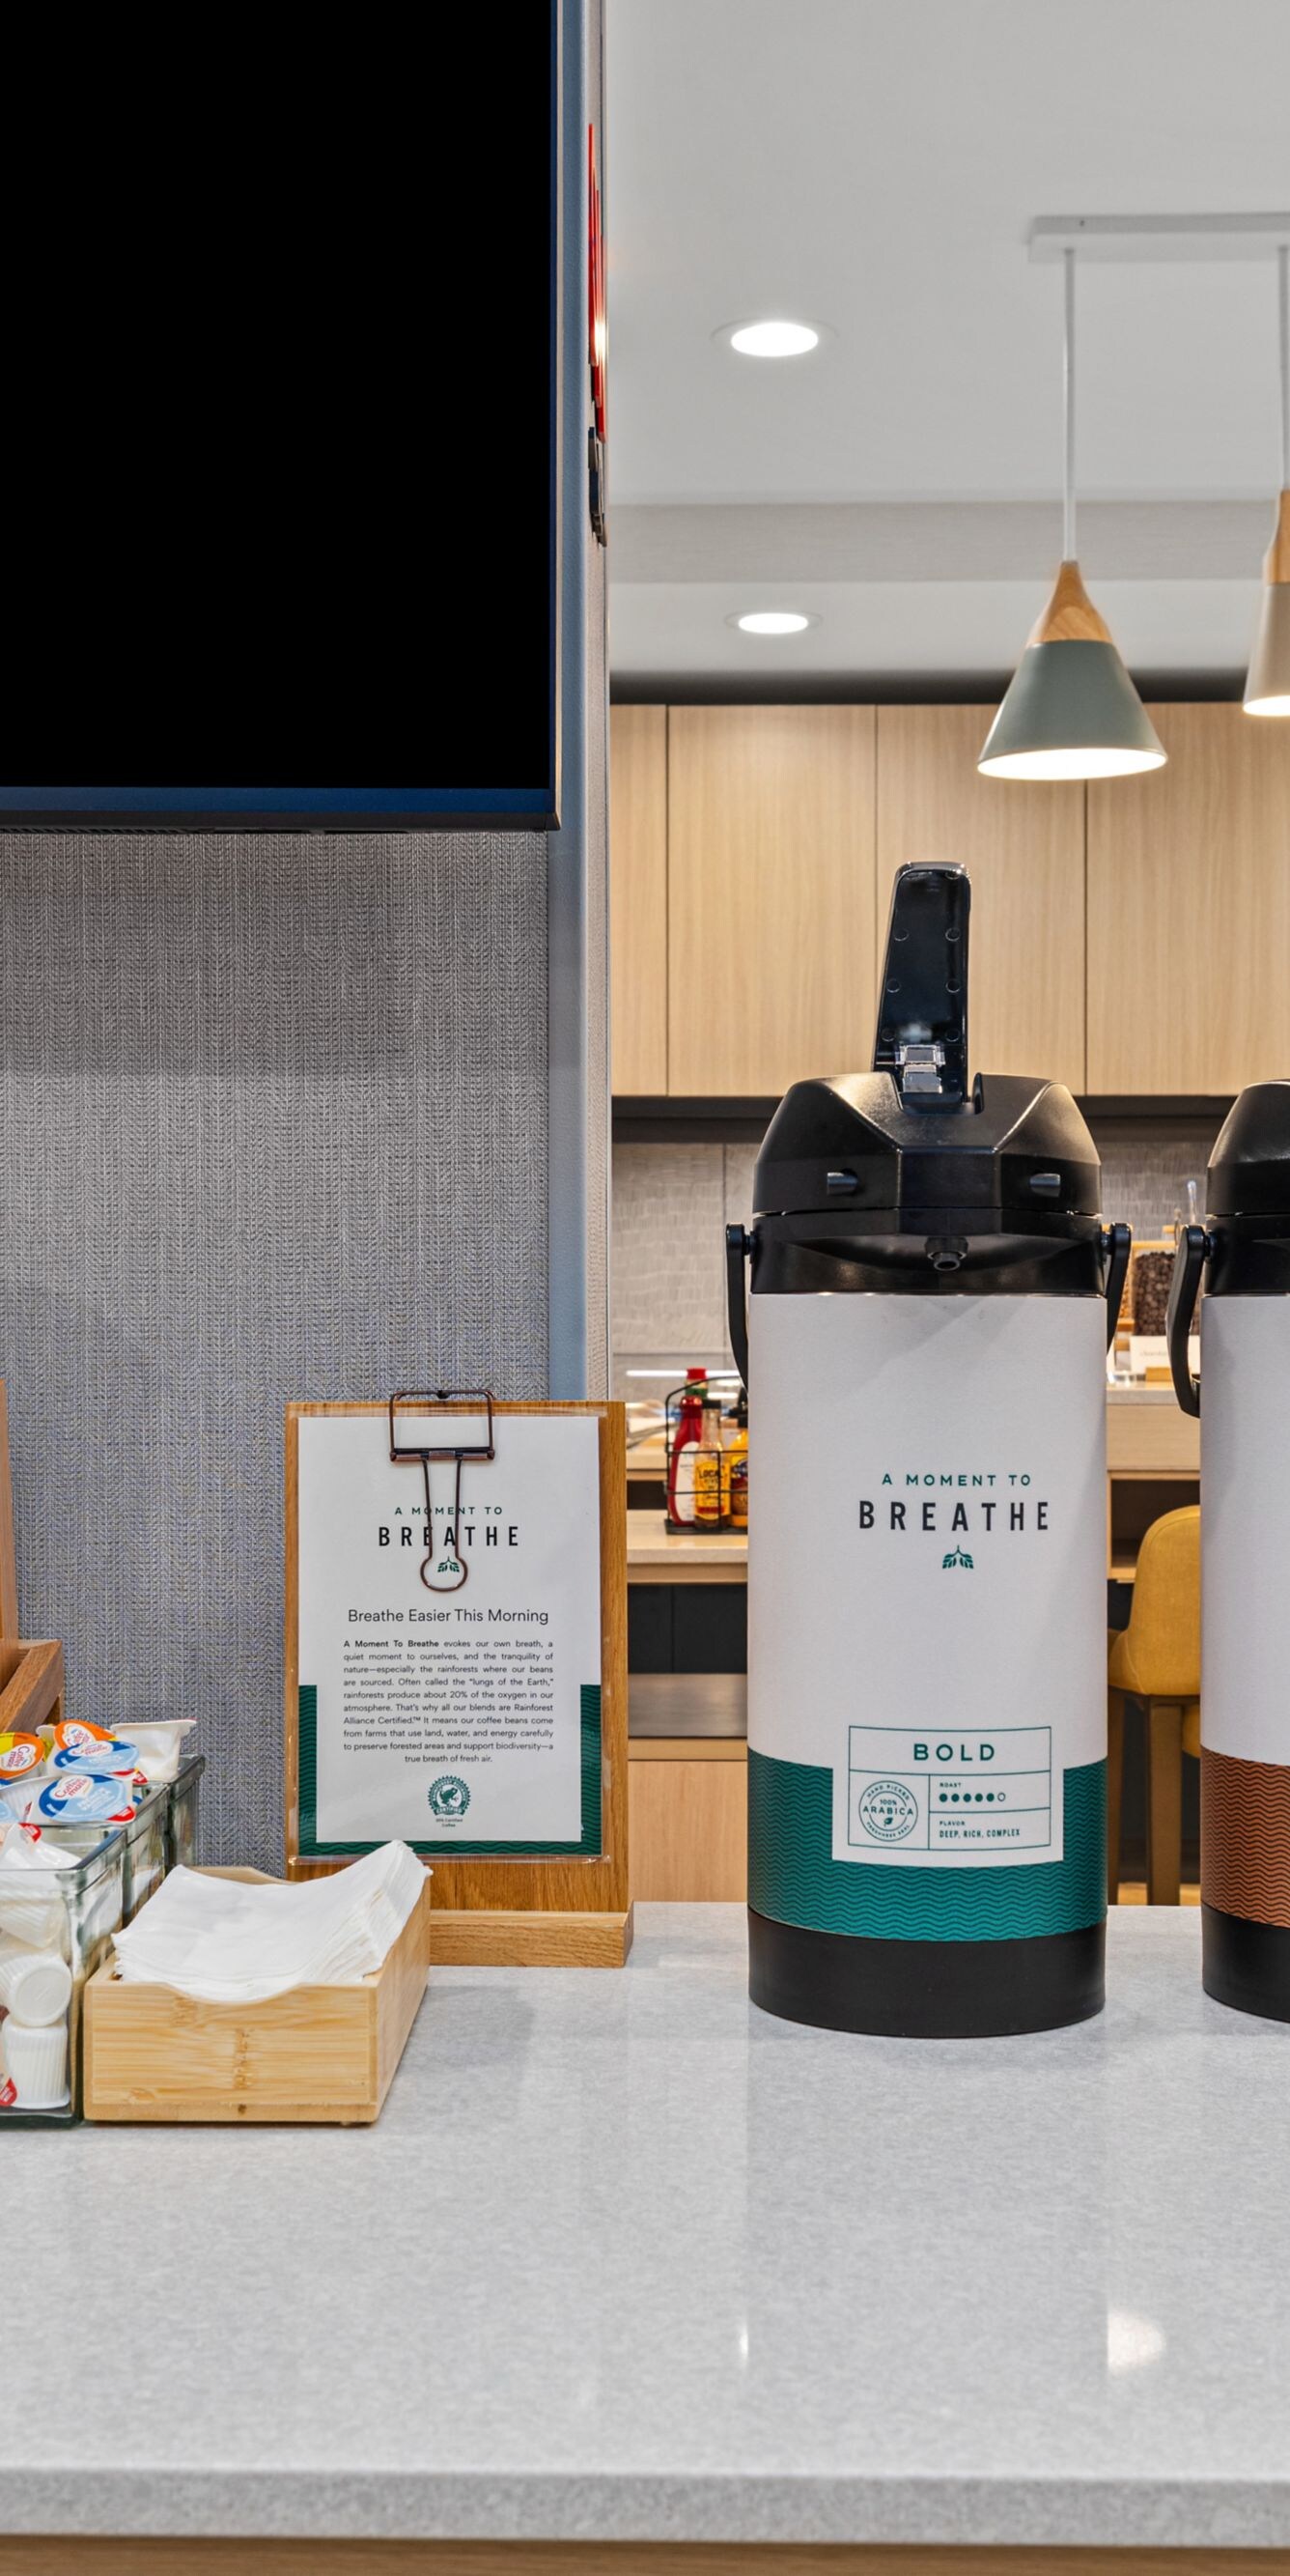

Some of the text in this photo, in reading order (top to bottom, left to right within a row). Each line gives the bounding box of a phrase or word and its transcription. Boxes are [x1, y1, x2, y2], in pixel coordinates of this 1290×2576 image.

[882, 1473, 1031, 1486] A MOMENT TO
[859, 1500, 1049, 1532] BREATHE
[379, 1526, 519, 1546] BREATHE
[349, 1608, 548, 1626] Breathe Easier This Morning
[407, 1639, 439, 1648] Breathe
[344, 1653, 364, 1662] quiet
[501, 1653, 541, 1661] tranquility
[387, 1690, 421, 1700] produce
[344, 1704, 393, 1713] atmosphere.
[422, 1704, 438, 1713] why
[425, 1729, 444, 1738] land,
[520, 1729, 553, 1739] carefully
[353, 1743, 388, 1752] preserve
[390, 1741, 422, 1750] forested
[463, 1742, 493, 1751] support
[913, 1743, 996, 1762] BOLD
[863, 1806, 913, 1816] ARABICA
[939, 1828, 1021, 1839] DEEP, RICH, COMPLEX
